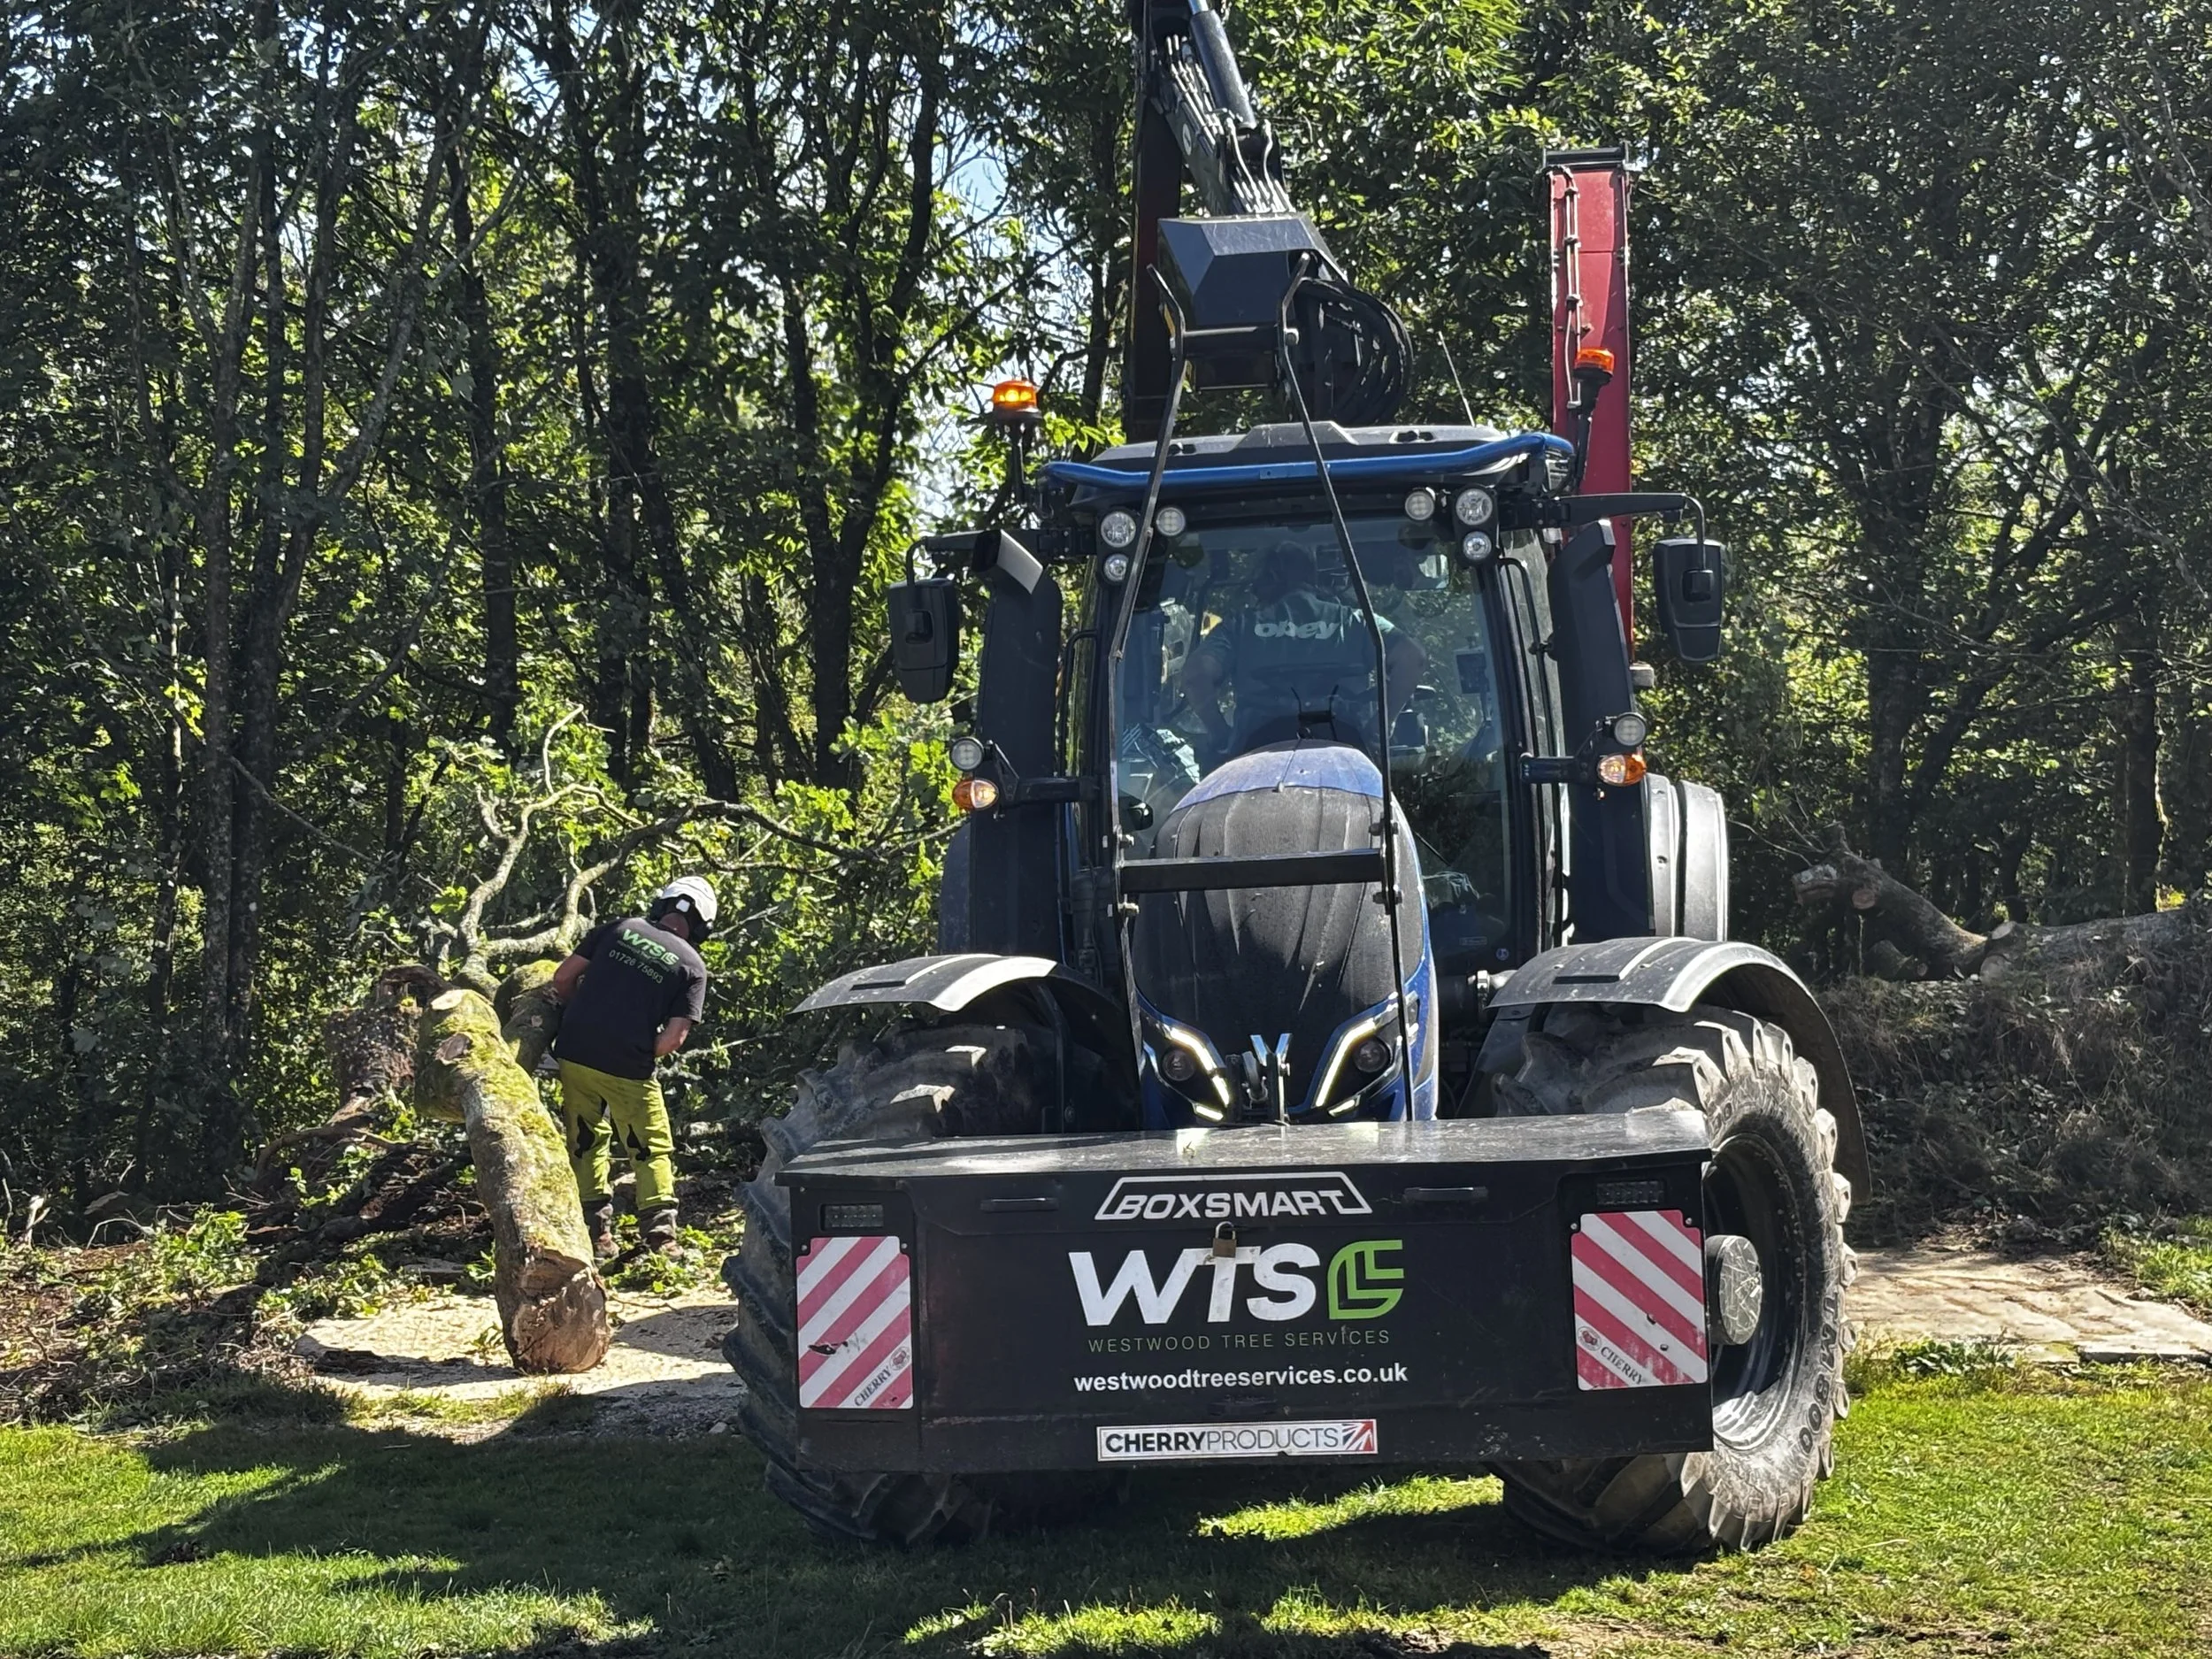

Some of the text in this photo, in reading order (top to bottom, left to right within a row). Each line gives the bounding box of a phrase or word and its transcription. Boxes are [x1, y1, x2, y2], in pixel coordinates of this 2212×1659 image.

[1112, 1190, 1345, 1221] BOXSMART
[1068, 1242, 1321, 1326] WTS
[1087, 1329, 1390, 1353] WESTWOOD TREE SERVICES
[854, 1365, 892, 1407] CHERRY
[1073, 1362, 1409, 1392] westwoodtreeservices.co.uk
